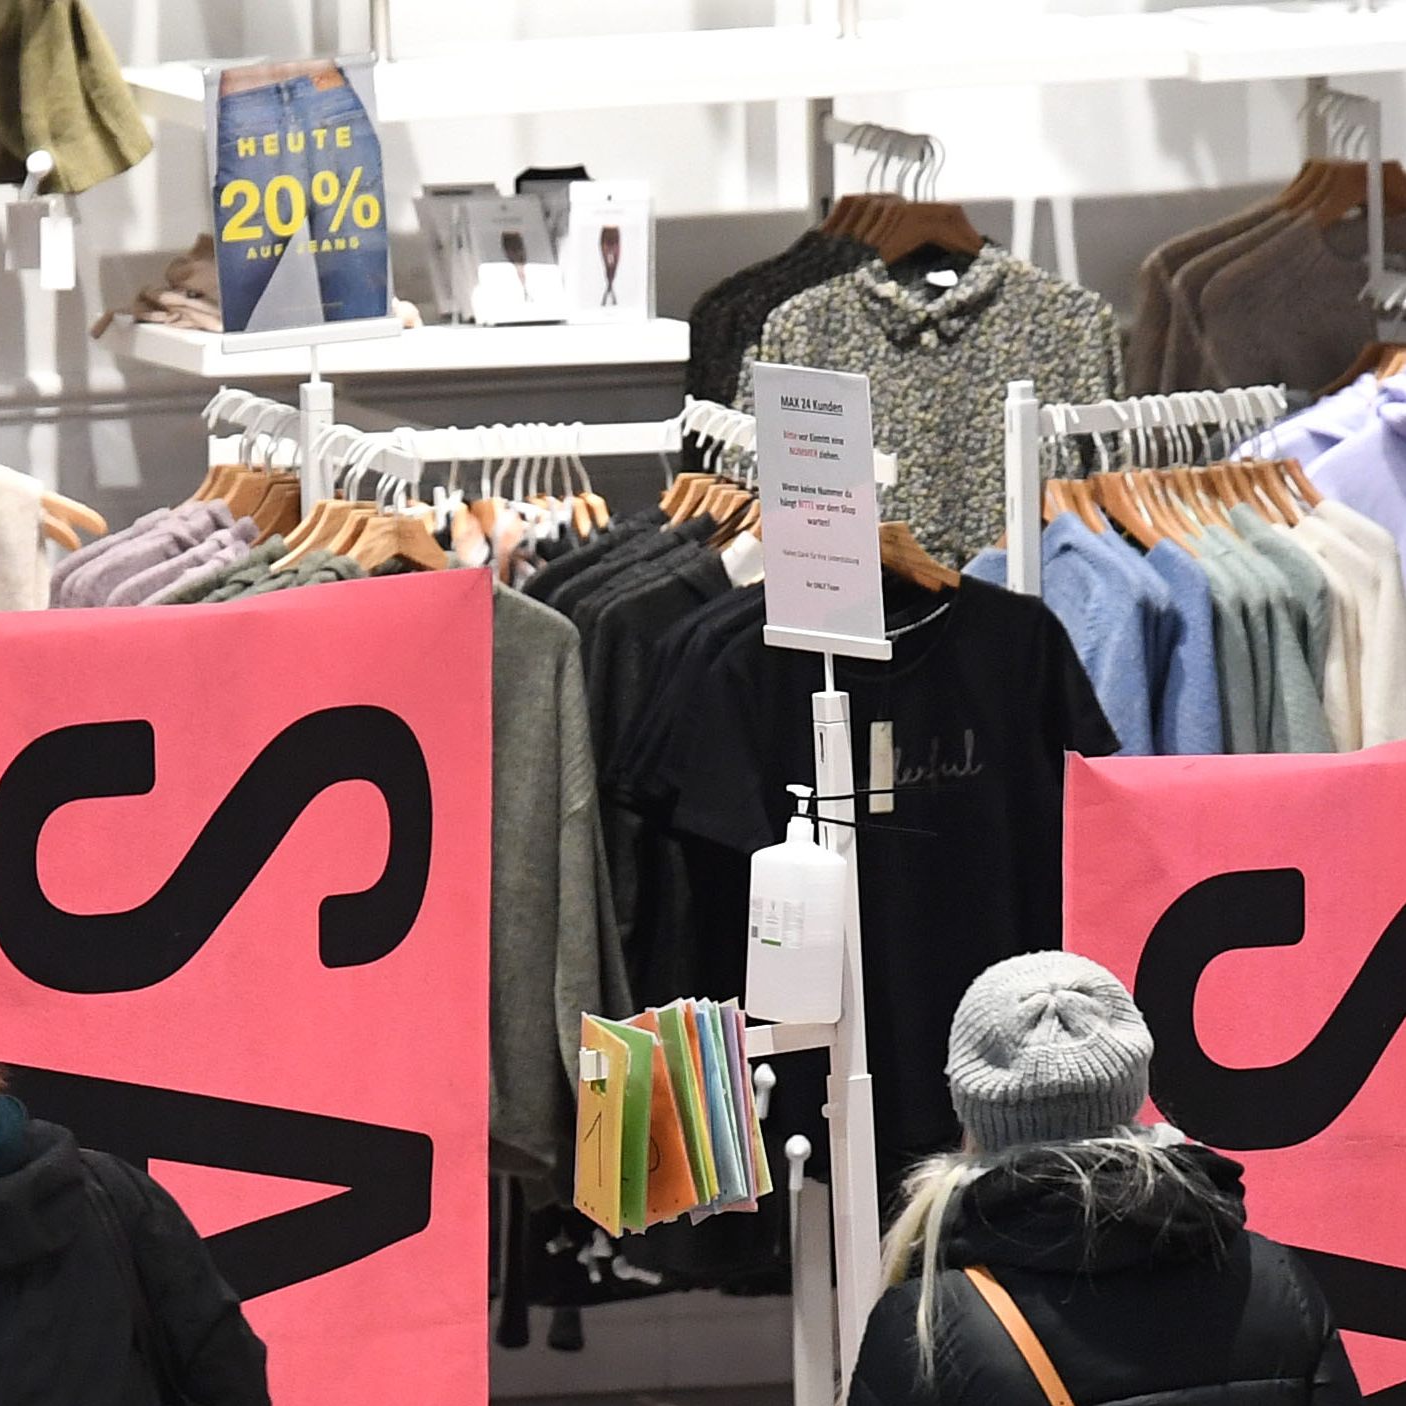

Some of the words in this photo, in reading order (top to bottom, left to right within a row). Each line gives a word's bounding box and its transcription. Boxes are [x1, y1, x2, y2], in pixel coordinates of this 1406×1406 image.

[237, 126, 352, 158] HEUTE
[219, 166, 381, 242] 20%
[247, 243, 284, 260] AUF
[780, 395, 800, 409] MAX
[800, 397, 812, 410] 24
[812, 399, 843, 414] Kunden
[583, 1110, 603, 1188] 1
